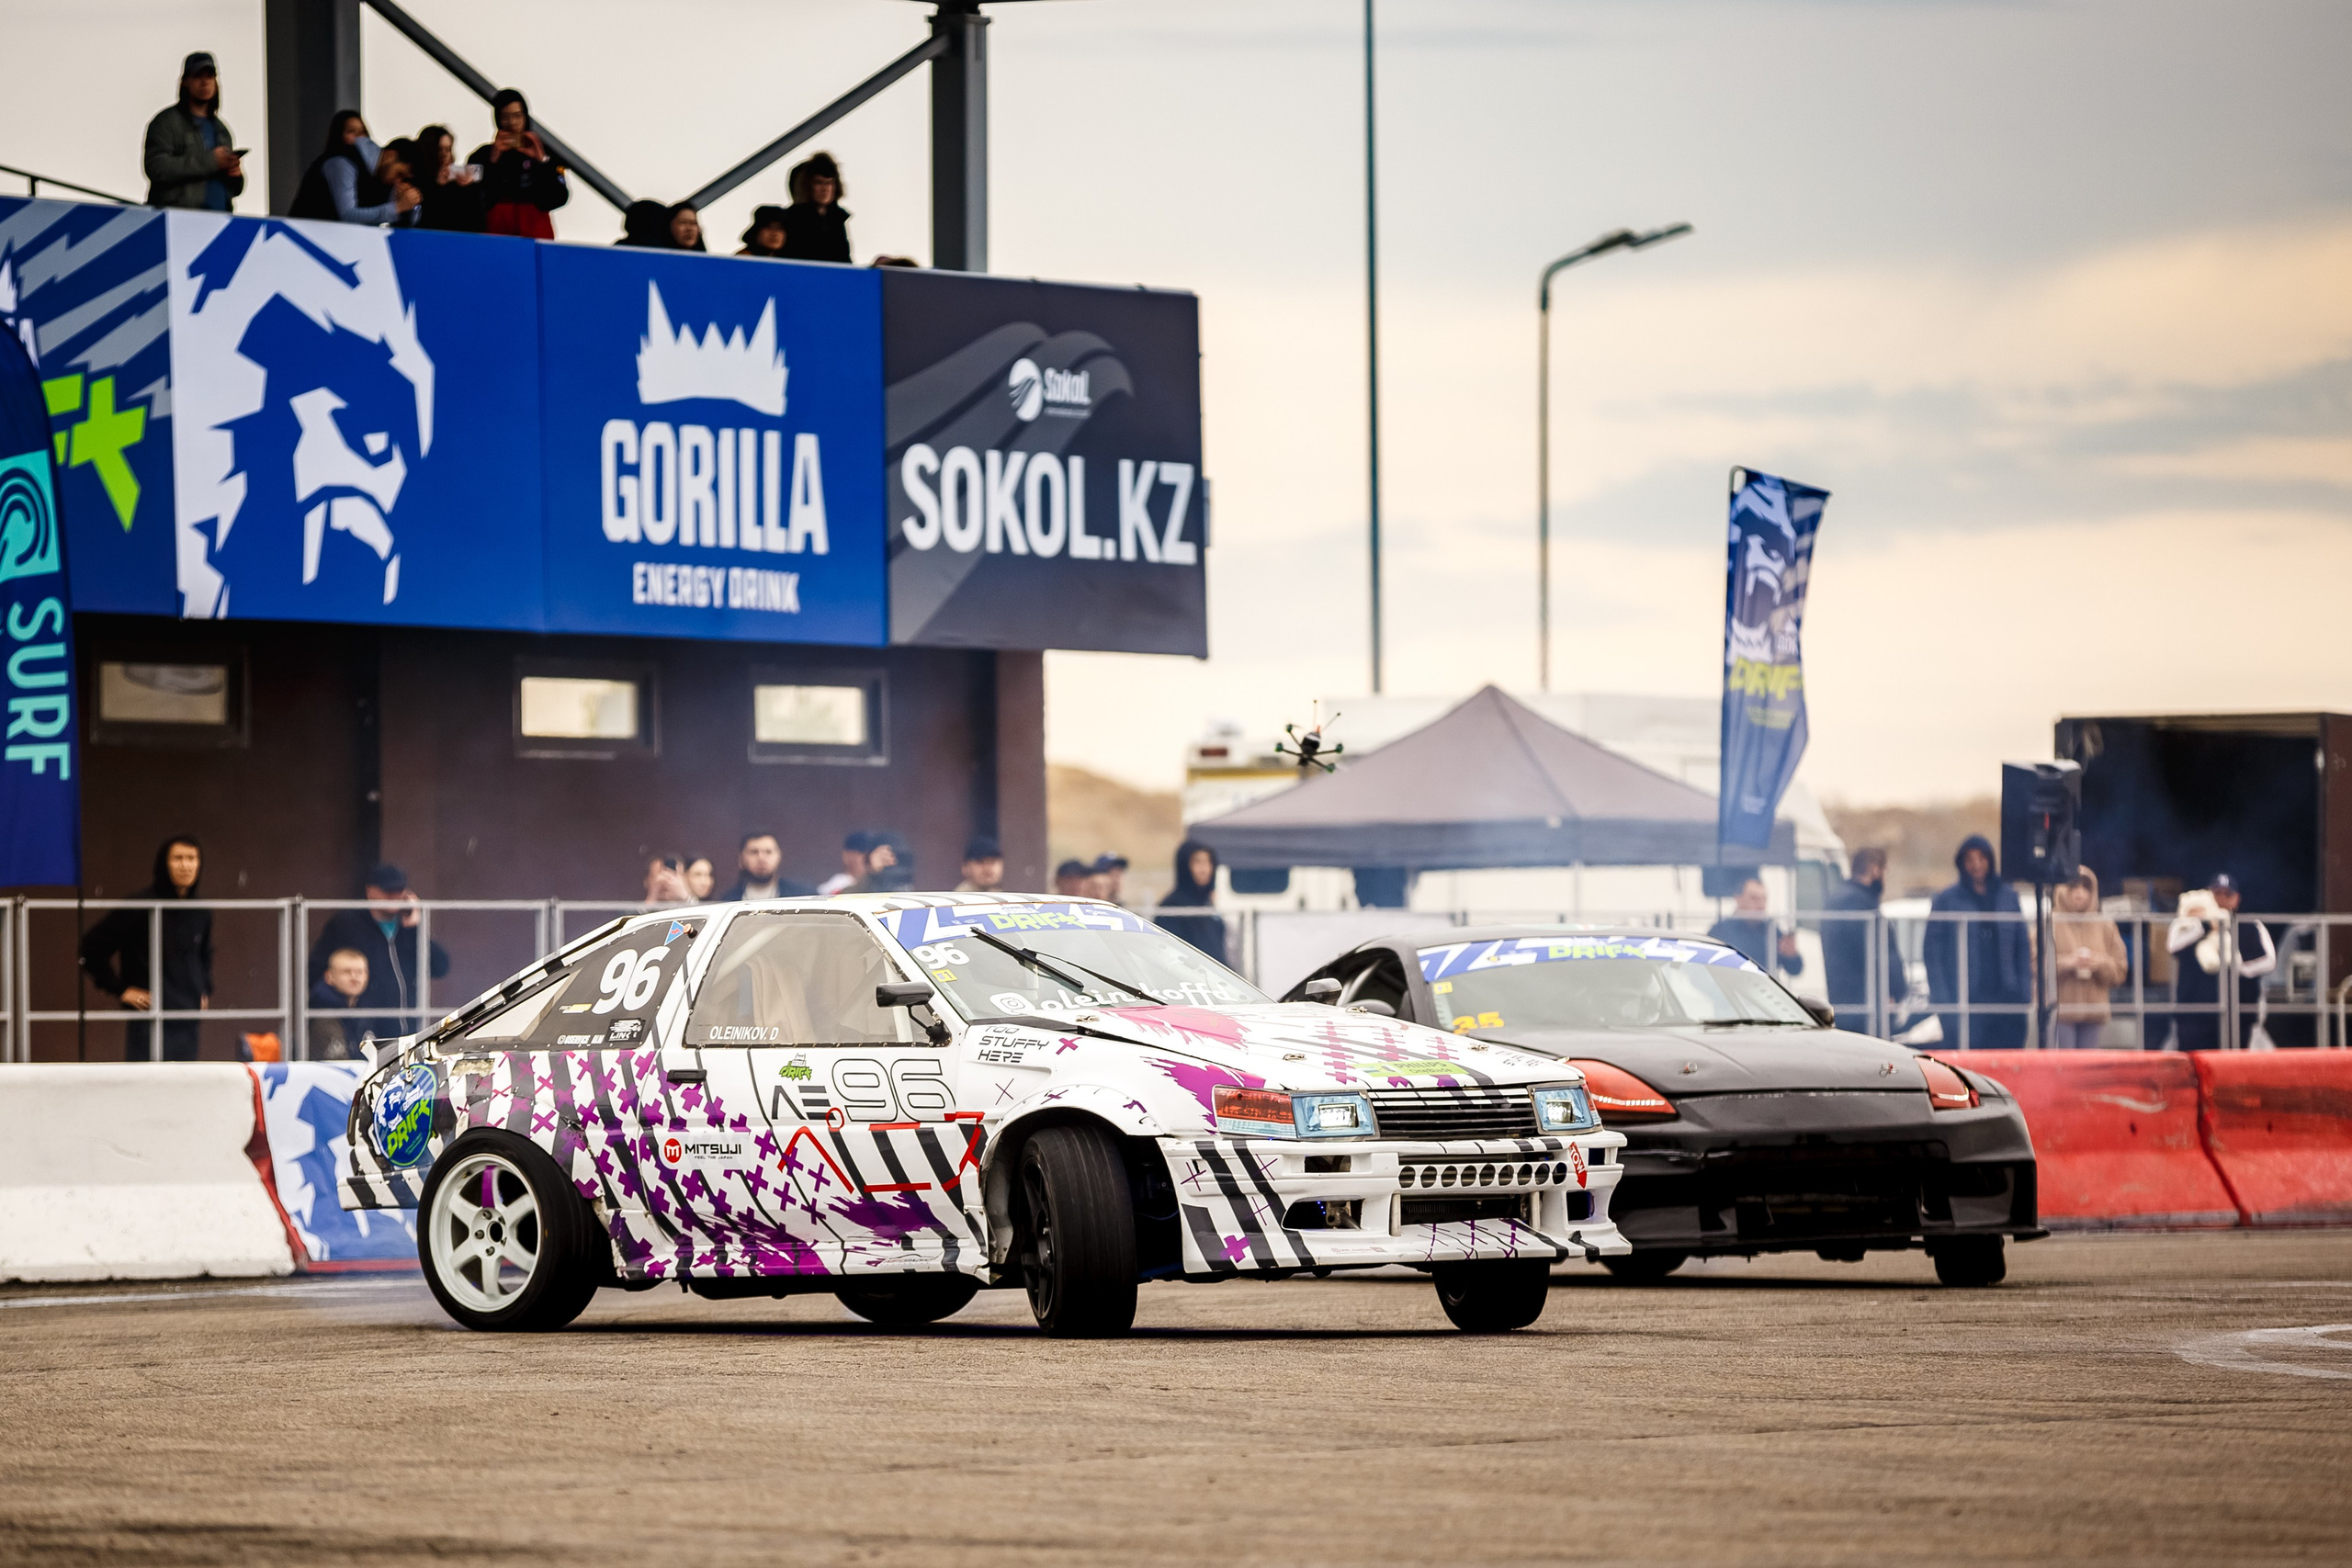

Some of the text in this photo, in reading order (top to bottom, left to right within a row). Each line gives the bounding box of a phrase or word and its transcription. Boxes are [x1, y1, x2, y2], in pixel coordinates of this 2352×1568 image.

[601, 418, 830, 555] GORILLA
[901, 443, 1196, 565] SOKOL.KZ
[632, 561, 801, 614] ENERGY DRINK
[5, 597, 71, 781] SURF
[988, 912, 1088, 930] DRIFT
[912, 942, 970, 970] 96
[592, 946, 671, 1014] 96
[709, 1025, 780, 1041] OLEINIKOV. D
[978, 1035, 1050, 1050] STUFFY
[985, 1025, 1020, 1034] TOO
[978, 1049, 1024, 1064] HERE
[1394, 1061, 1448, 1069] PHILIPS
[831, 1058, 956, 1122] 96
[387, 1098, 431, 1158] DRIFT
[684, 1144, 741, 1155] MITSUJI
[1570, 1145, 1586, 1174] TOW
